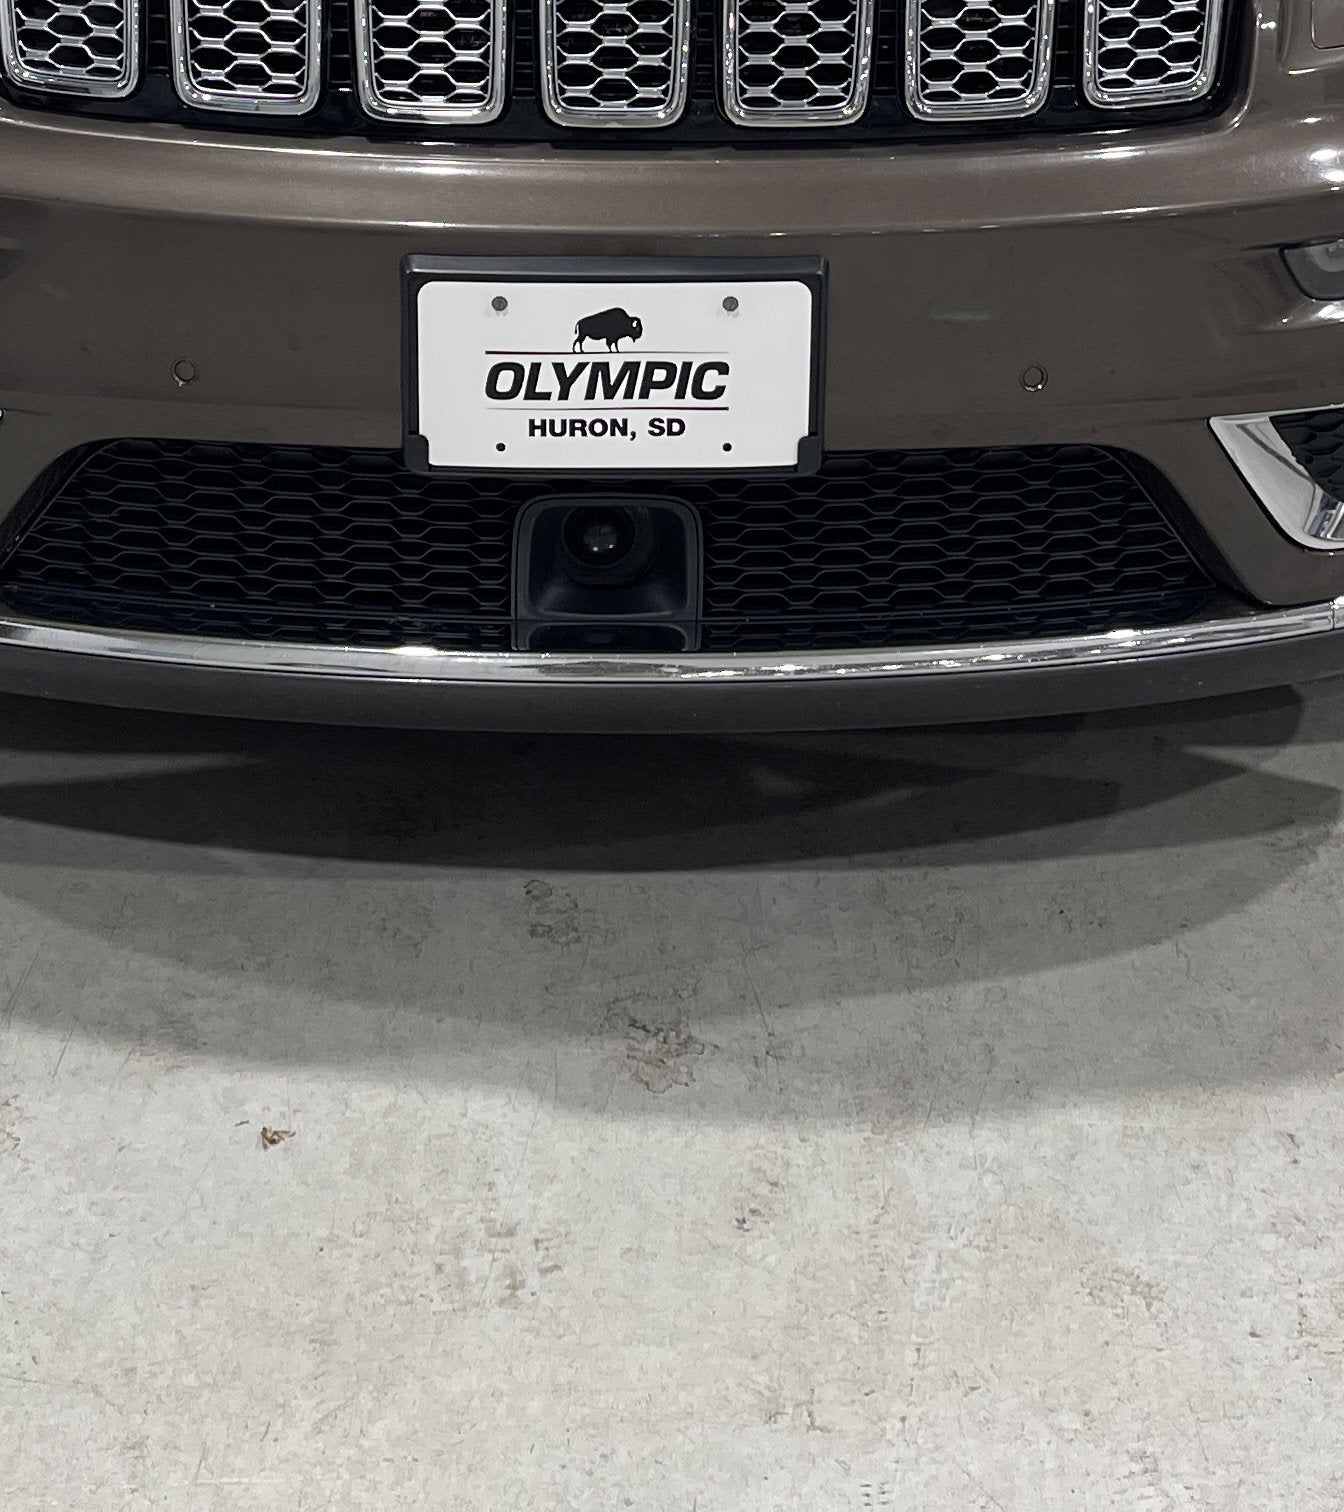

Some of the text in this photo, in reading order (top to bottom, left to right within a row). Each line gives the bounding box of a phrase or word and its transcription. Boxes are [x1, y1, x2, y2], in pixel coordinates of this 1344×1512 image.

[484, 360, 730, 401] OLYMPIC
[528, 417, 686, 442] HURON, SD
